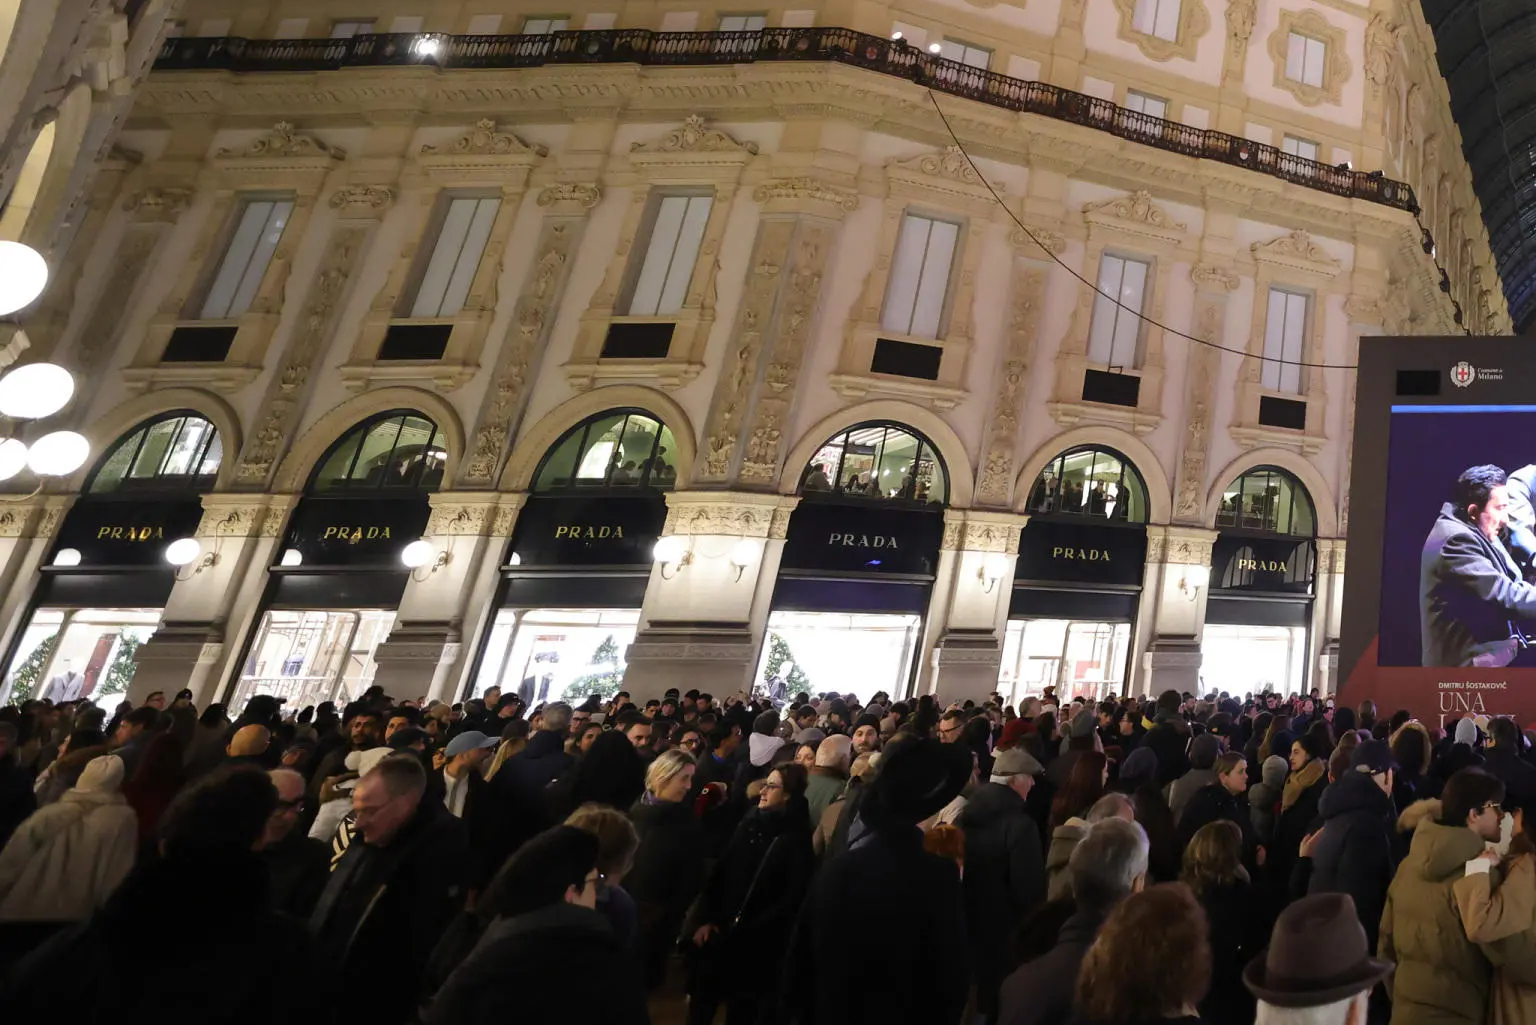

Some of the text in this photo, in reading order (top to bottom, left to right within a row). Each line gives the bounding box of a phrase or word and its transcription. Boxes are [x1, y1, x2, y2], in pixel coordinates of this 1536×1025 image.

[97, 526, 163, 540] PRADA
[323, 526, 391, 540] PRADA
[555, 526, 623, 539] PRADA
[828, 533, 898, 549] PRADA
[1053, 547, 1111, 561] PRADA
[1238, 559, 1287, 572] PRADA
[1438, 691, 1487, 712] UNA
